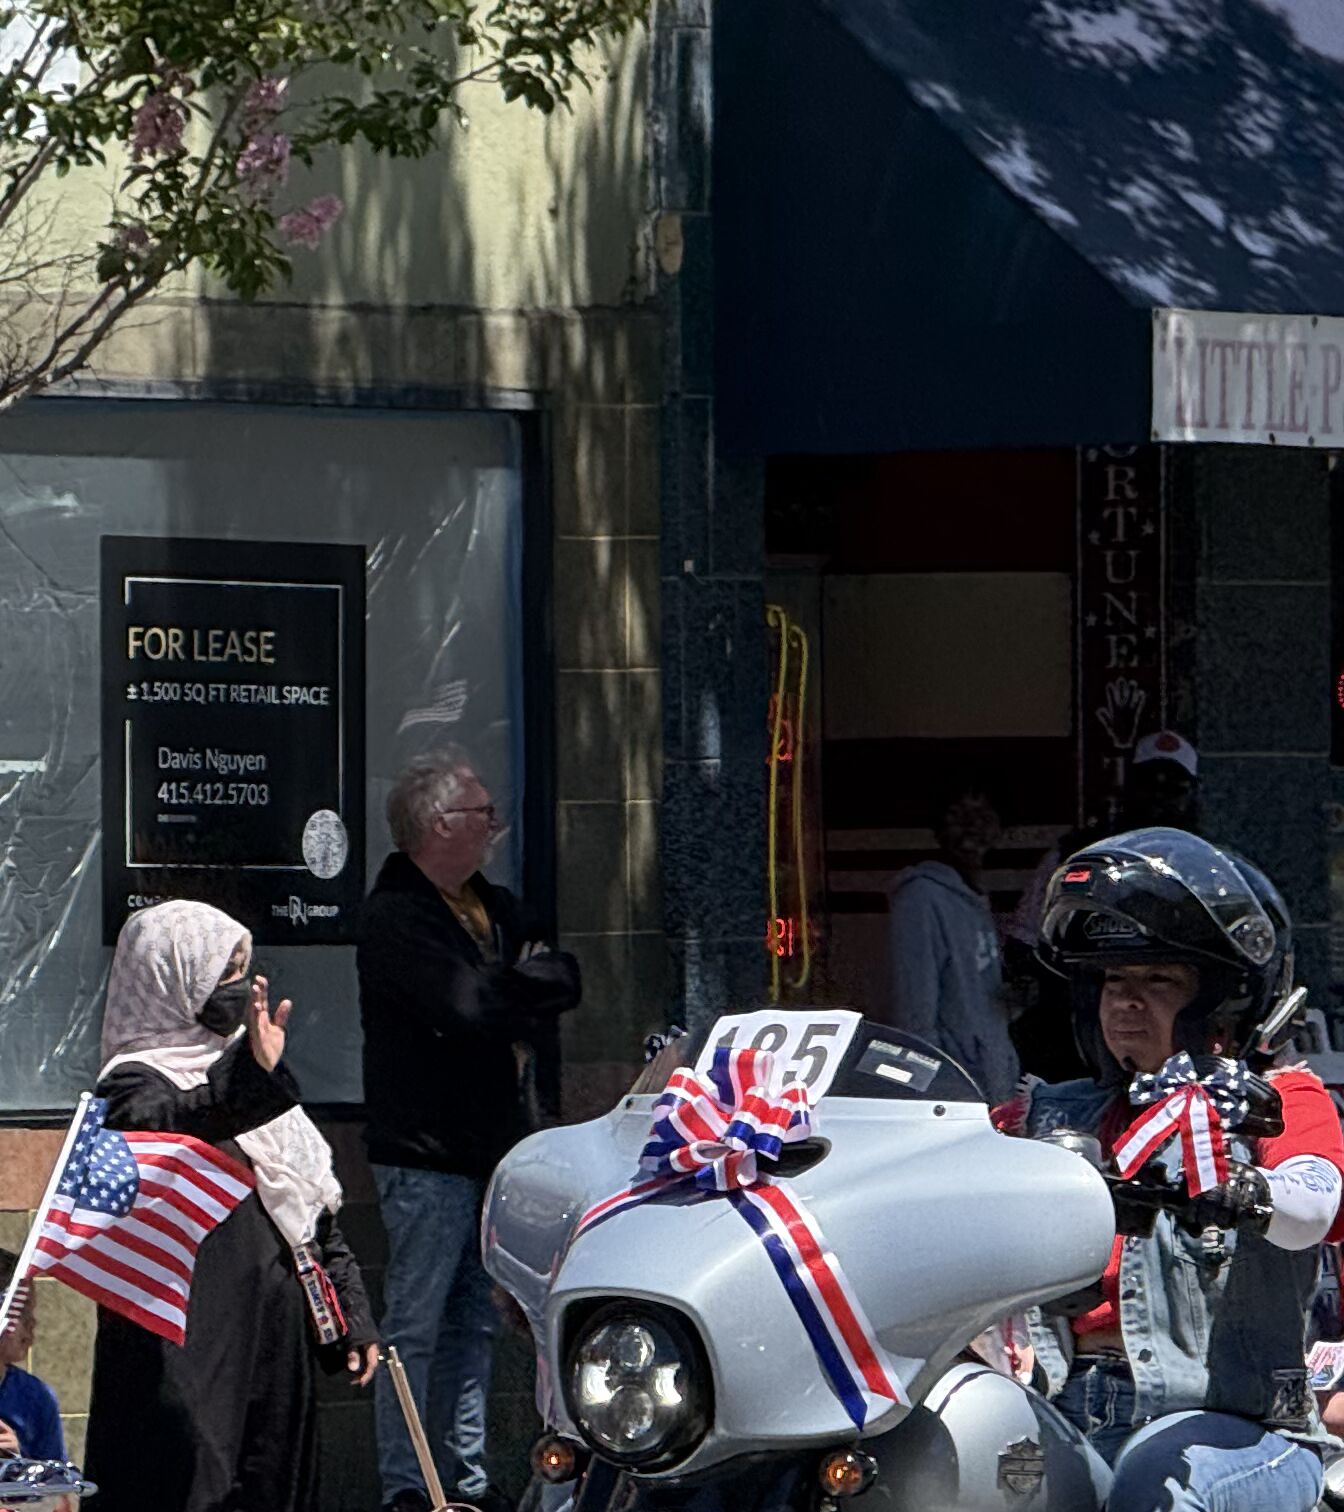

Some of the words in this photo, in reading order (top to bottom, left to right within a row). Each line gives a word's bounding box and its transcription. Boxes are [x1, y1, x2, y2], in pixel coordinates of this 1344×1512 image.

[1175, 337, 1308, 431] LITTLE
[128, 627, 185, 660] FOR
[193, 630, 276, 664] LEASE
[140, 682, 180, 702] 1,500
[183, 683, 206, 704] SQ
[208, 684, 229, 702] FT
[230, 685, 280, 704] RETAIL
[282, 686, 330, 705] SPACE
[158, 747, 202, 769] Davis
[206, 748, 267, 775] Nguyen
[157, 782, 270, 806] 415.412.5703
